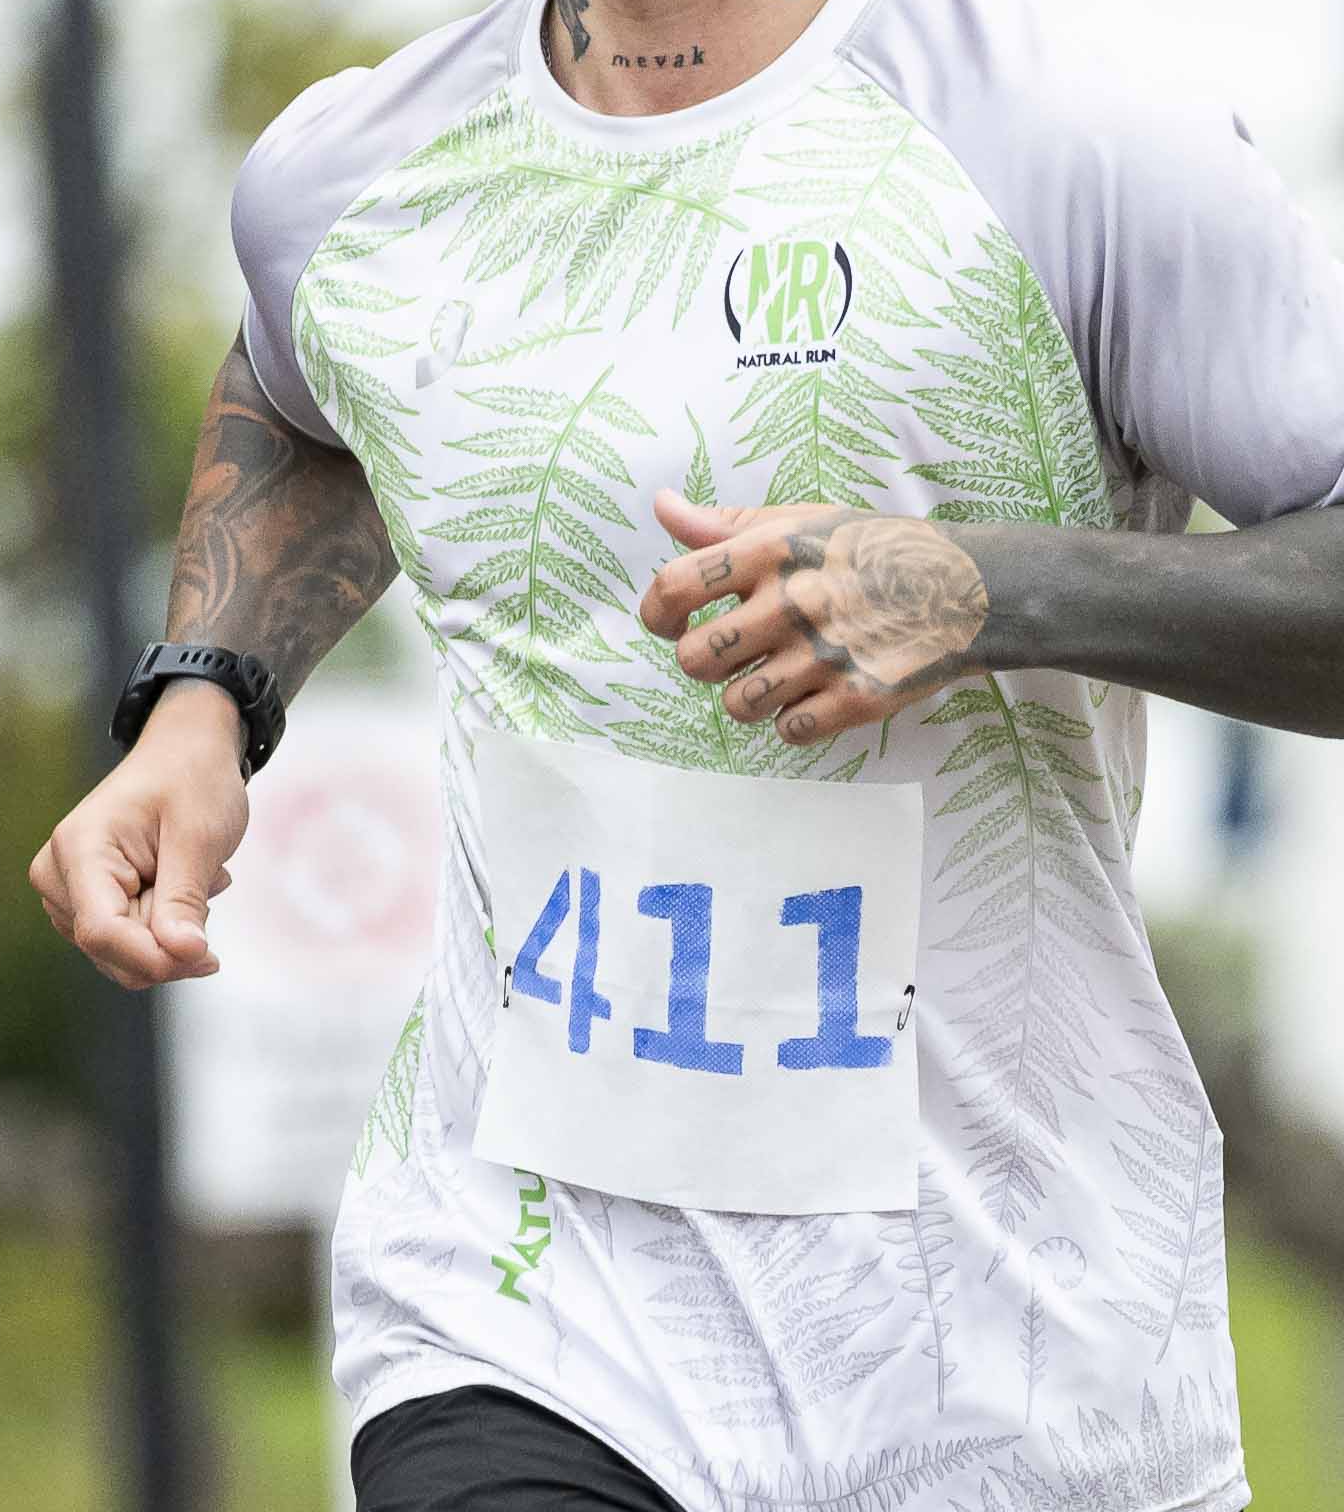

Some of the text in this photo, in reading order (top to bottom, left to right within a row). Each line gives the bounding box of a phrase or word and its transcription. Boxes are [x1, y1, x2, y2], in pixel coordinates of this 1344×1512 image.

[736, 348, 837, 369] NATURAL RUN
[511, 865, 896, 1076] 411
